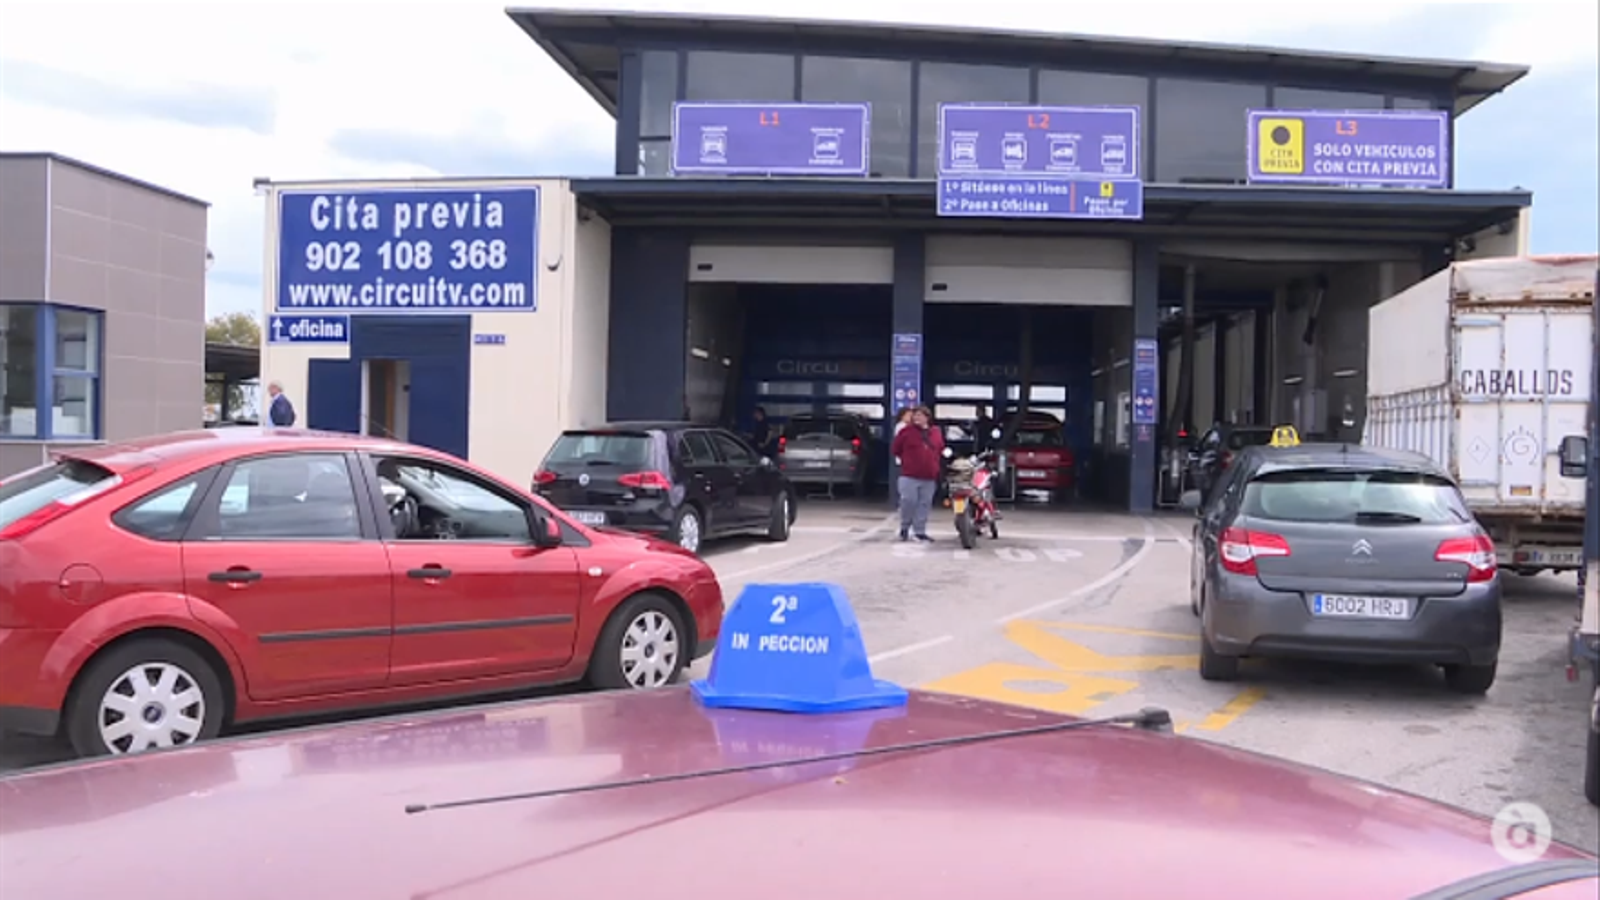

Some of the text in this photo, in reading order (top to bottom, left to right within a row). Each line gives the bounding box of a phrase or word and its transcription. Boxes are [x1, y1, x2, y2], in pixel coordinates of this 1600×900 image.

[760, 111, 779, 126] L1
[1028, 114, 1049, 129] L2
[1336, 120, 1357, 135] L3
[1314, 142, 1436, 158] SOLO VEHICULOS
[1313, 159, 1436, 176] CON CITA PREVIA
[311, 194, 504, 237] Cita previa
[306, 240, 507, 271] 902 108 368
[288, 276, 525, 306] www.circuitv.com
[289, 318, 344, 338] oficina
[1460, 369, 1573, 396] CABALLOS
[769, 595, 799, 624] 2ª
[732, 632, 829, 654] IN PECCION
